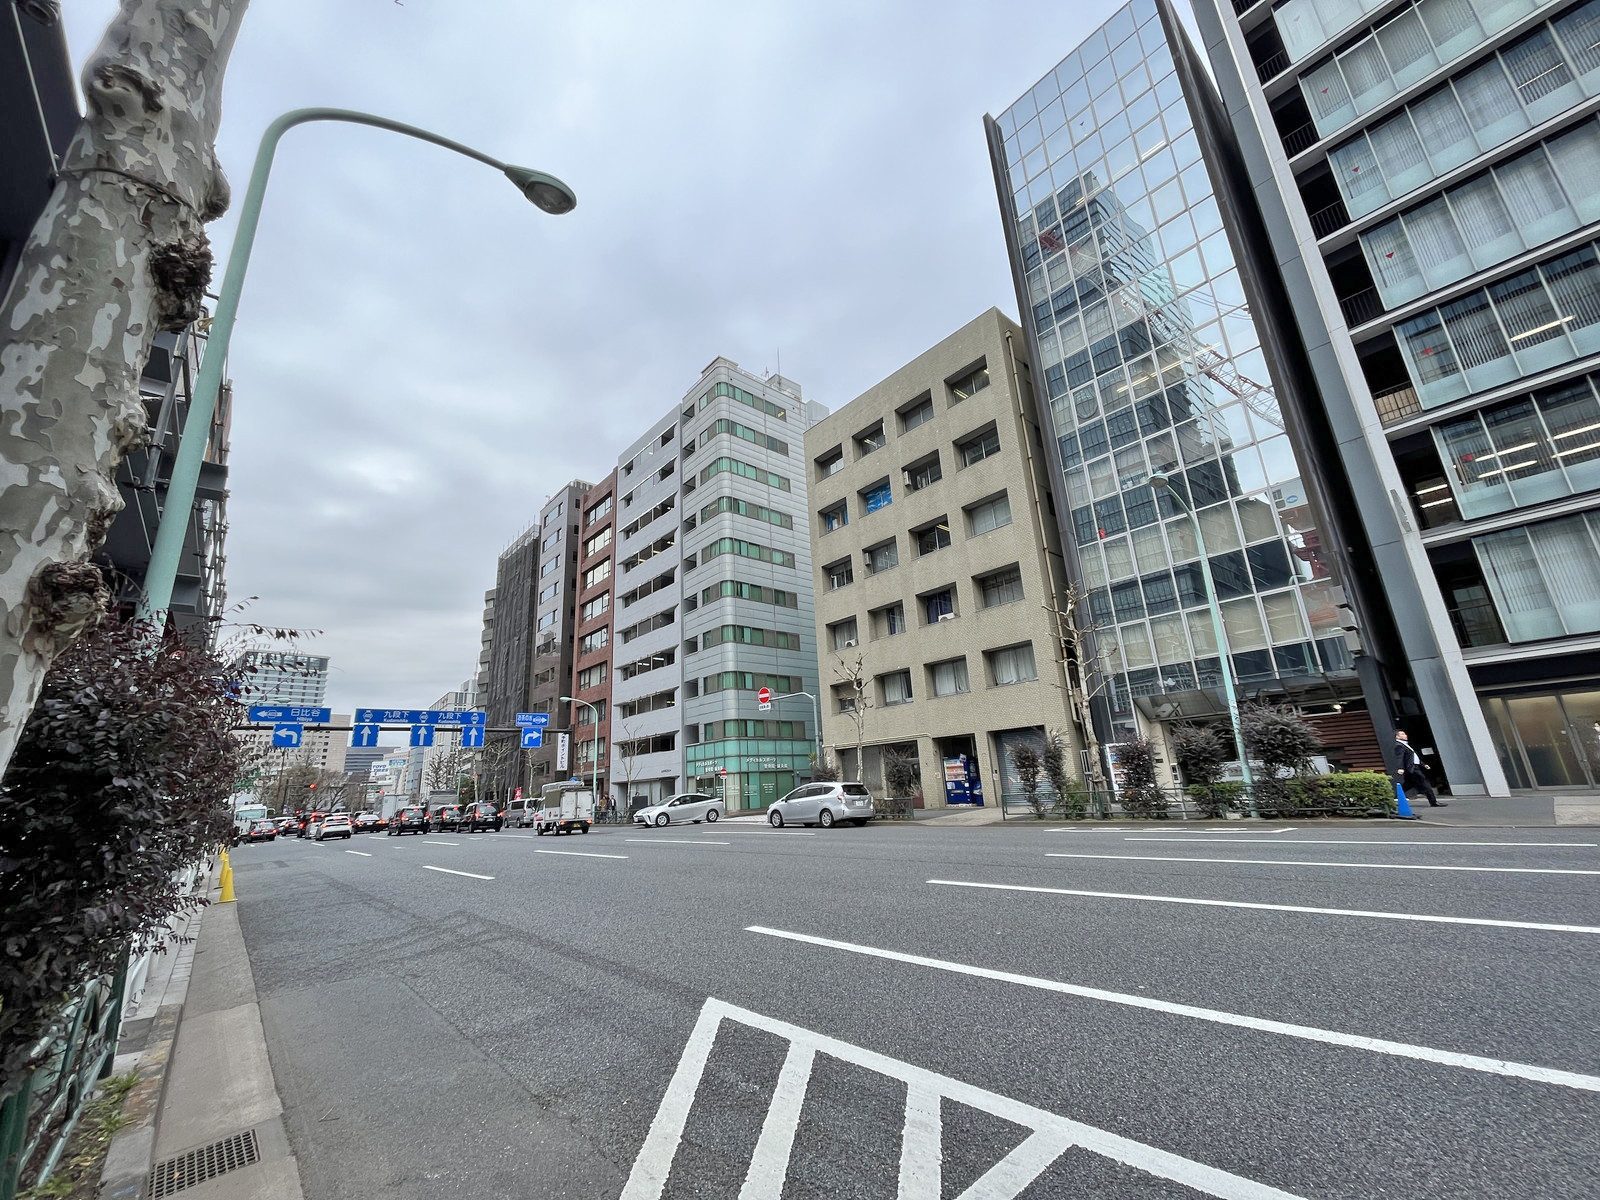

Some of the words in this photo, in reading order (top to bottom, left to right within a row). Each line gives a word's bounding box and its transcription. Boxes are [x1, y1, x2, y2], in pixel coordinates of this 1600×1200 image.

[291, 708, 321, 717] 日比谷
[383, 710, 410, 718] 九段下
